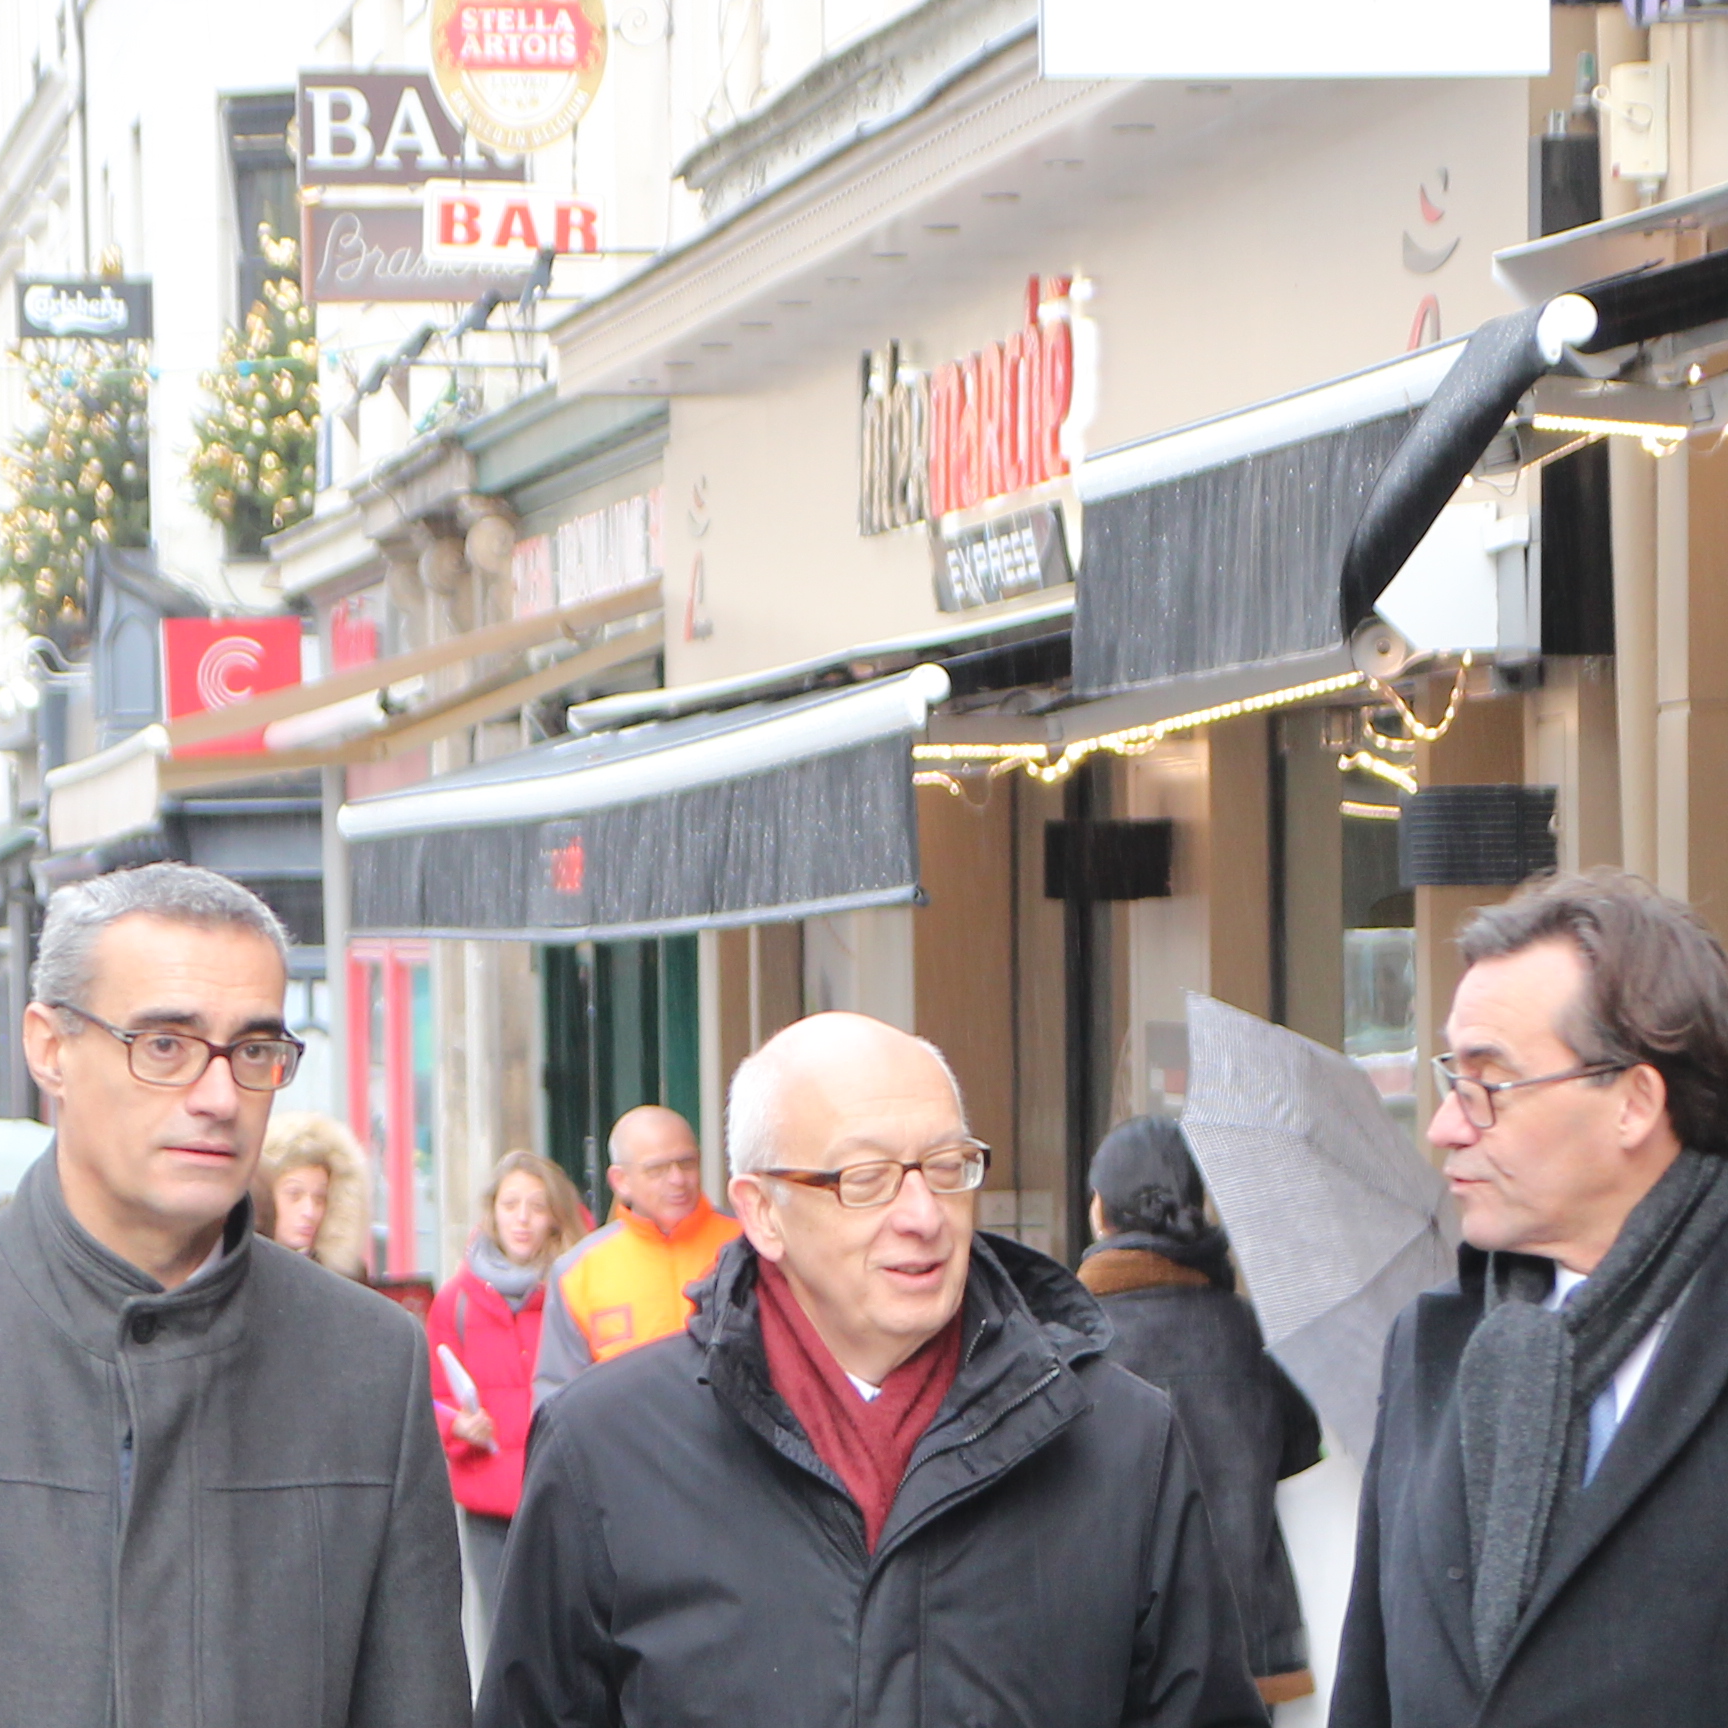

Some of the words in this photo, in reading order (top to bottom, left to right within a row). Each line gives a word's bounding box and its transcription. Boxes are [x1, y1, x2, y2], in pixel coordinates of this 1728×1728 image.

[460, 7, 575, 34] STELLA
[460, 34, 578, 62] ARTOIS
[305, 86, 520, 172] BA
[449, 87, 504, 142] BREWED
[506, 130, 526, 146] IN
[530, 87, 590, 146] BELGIUM
[438, 198, 600, 254] BAR
[24, 284, 129, 334] Carlsberg
[947, 527, 1042, 602] EXPRESS
